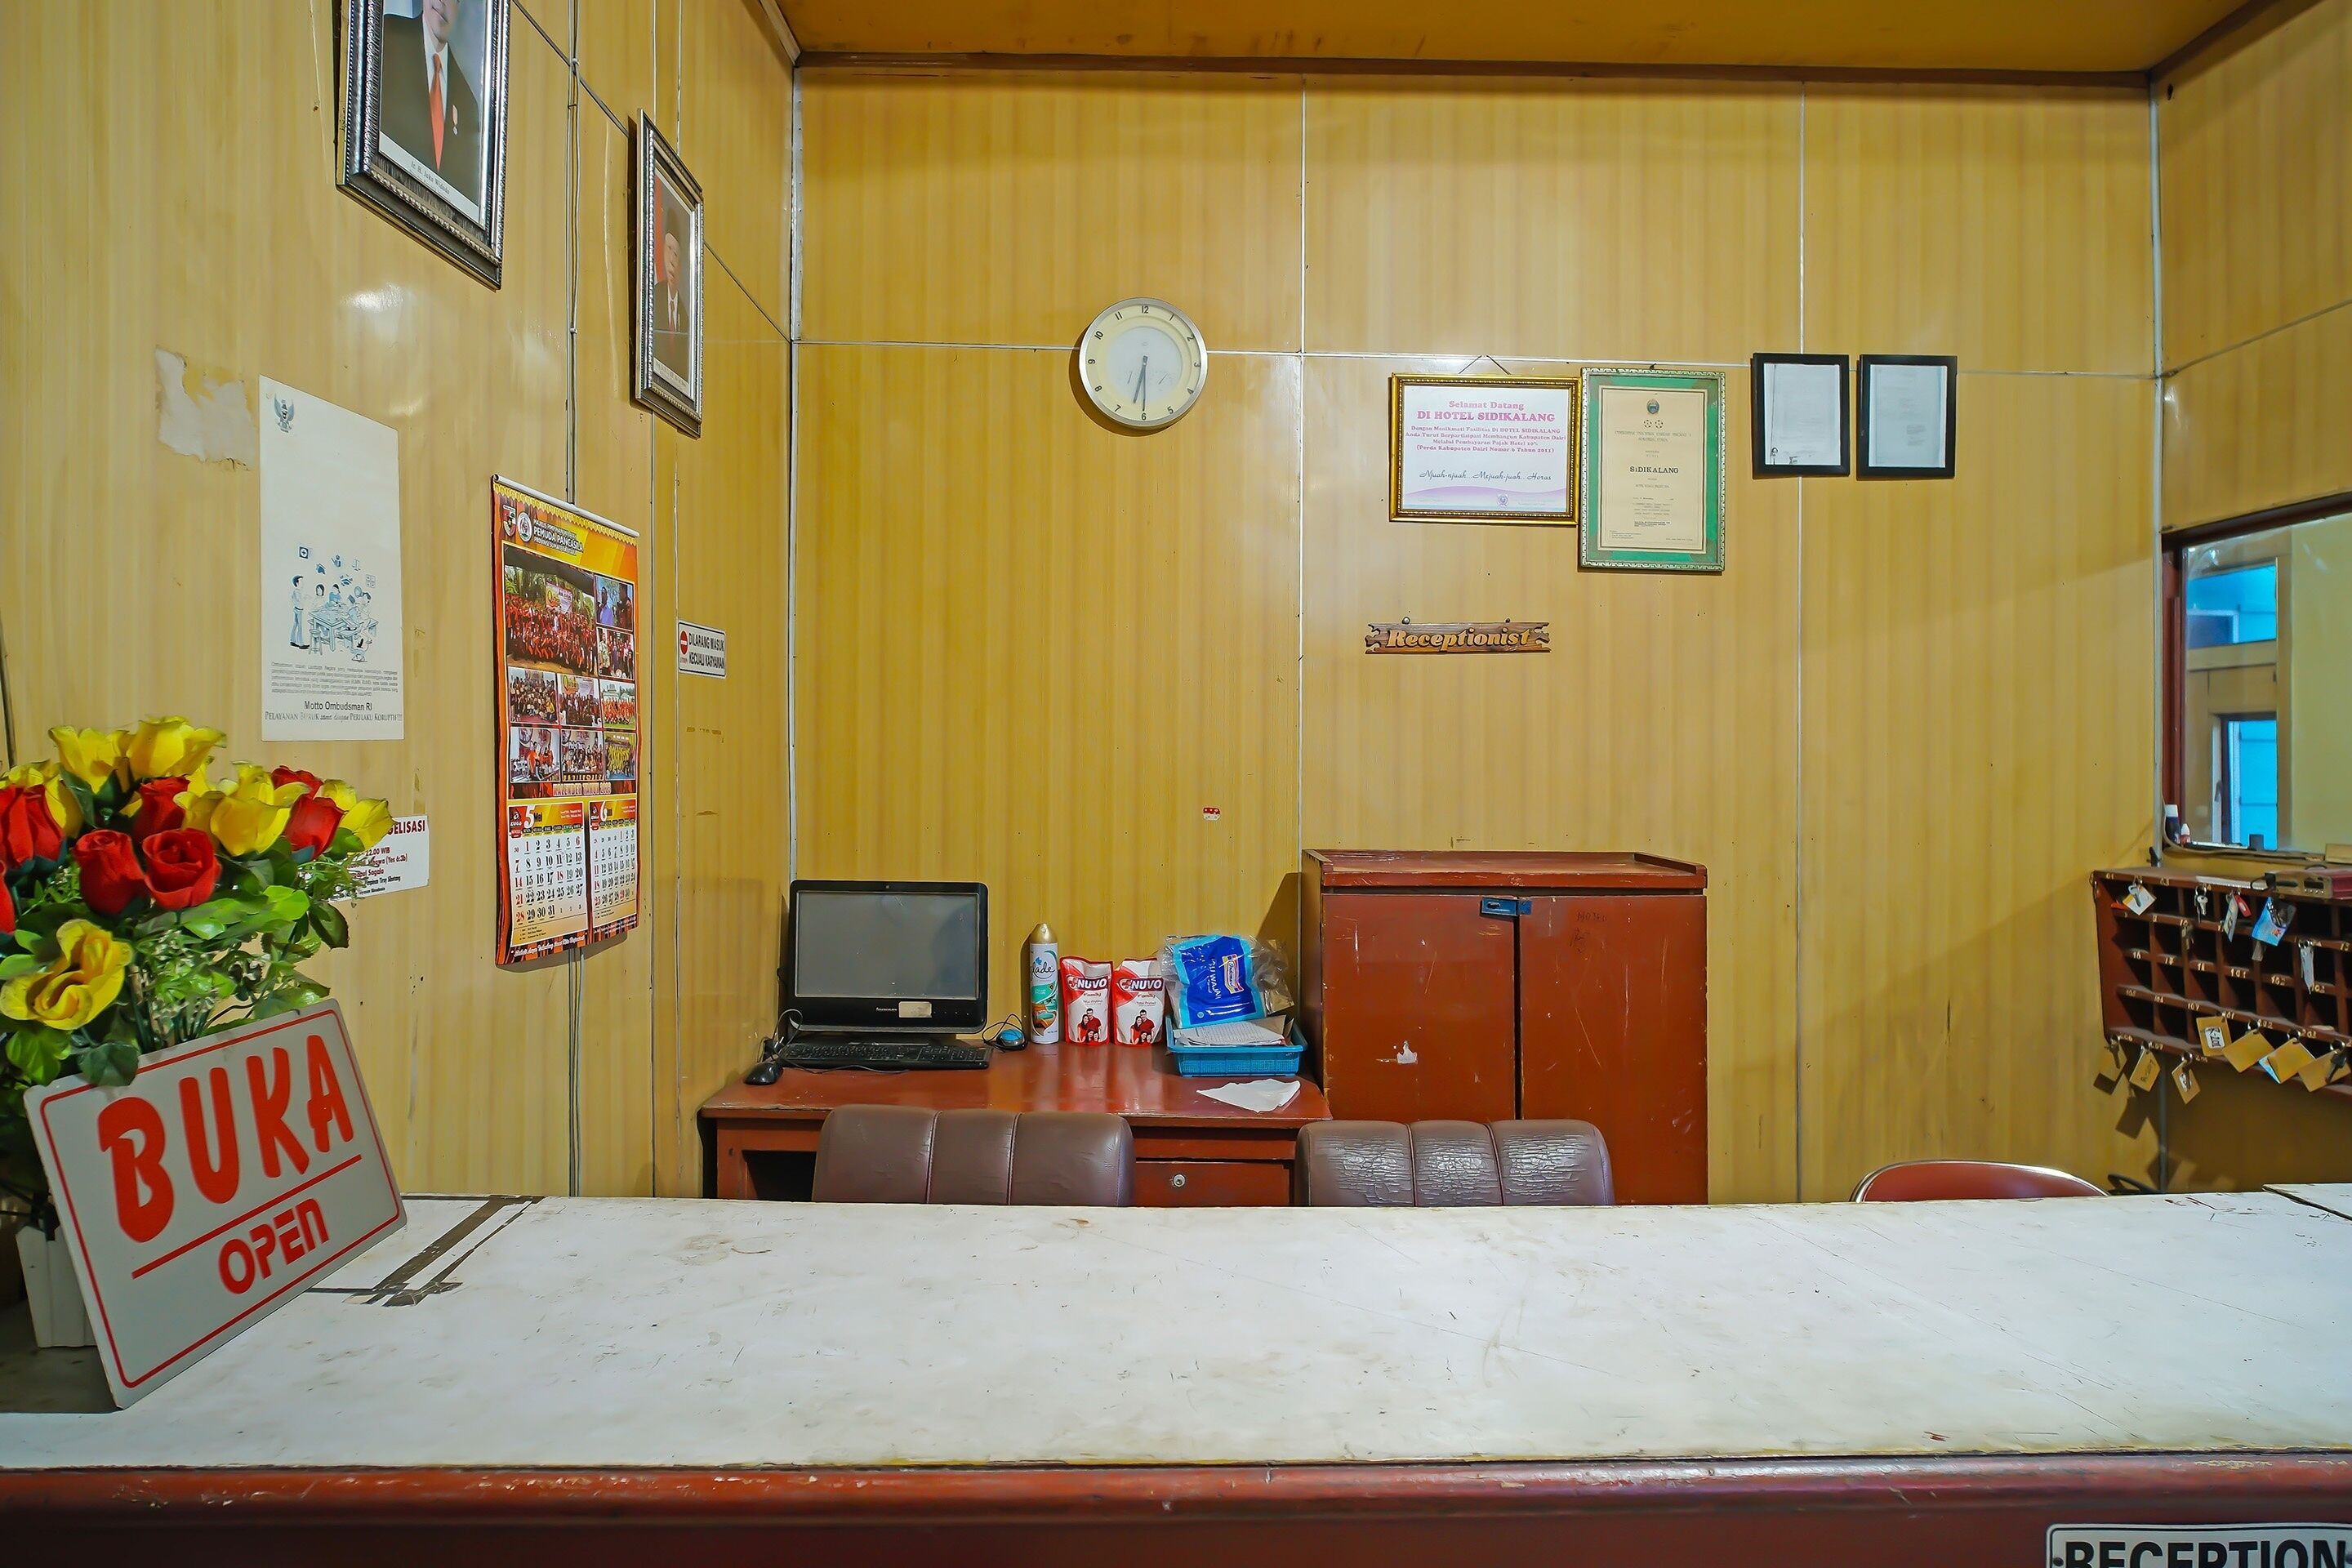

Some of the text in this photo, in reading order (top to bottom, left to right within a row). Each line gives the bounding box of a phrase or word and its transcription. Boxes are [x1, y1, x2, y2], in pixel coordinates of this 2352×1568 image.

[1141, 305, 1149, 314] 12
[1115, 311, 1123, 320] 11
[1094, 331, 1104, 340] 10
[1114, 404, 1121, 412] 7
[1168, 406, 1174, 414] 5
[1490, 402, 1525, 411] Datang
[1417, 411, 1556, 422] DI HOTEL SIDIKALANG
[1527, 472, 1552, 481] Horas
[534, 527, 556, 542] PEMUDA
[689, 633, 724, 652] DILARANG MASUK
[1385, 627, 1530, 652] Receptionist
[689, 652, 724, 669] KECUALI KARYAWAN
[304, 701, 372, 711] Motto Ombudsman RI
[265, 711, 298, 720] PELAYANAN
[524, 804, 536, 829] 5
[600, 801, 608, 822] 6
[526, 836, 580, 852] 1 2 3 4 5 6
[386, 856, 395, 865] (Yes
[515, 852, 582, 873] 7 8 9 10 11 12 13
[515, 867, 583, 888] 14 15 16 17 18 19 20
[516, 884, 583, 905] 21 22 23 24 25 26 27
[516, 905, 555, 923] 28 29 30 31
[2230, 969, 2247, 978] 101
[1076, 978, 1107, 989] NUVO
[1131, 979, 1162, 990] NUVO
[96, 1033, 356, 1245] BUKA
[217, 1197, 331, 1296] OPEN
